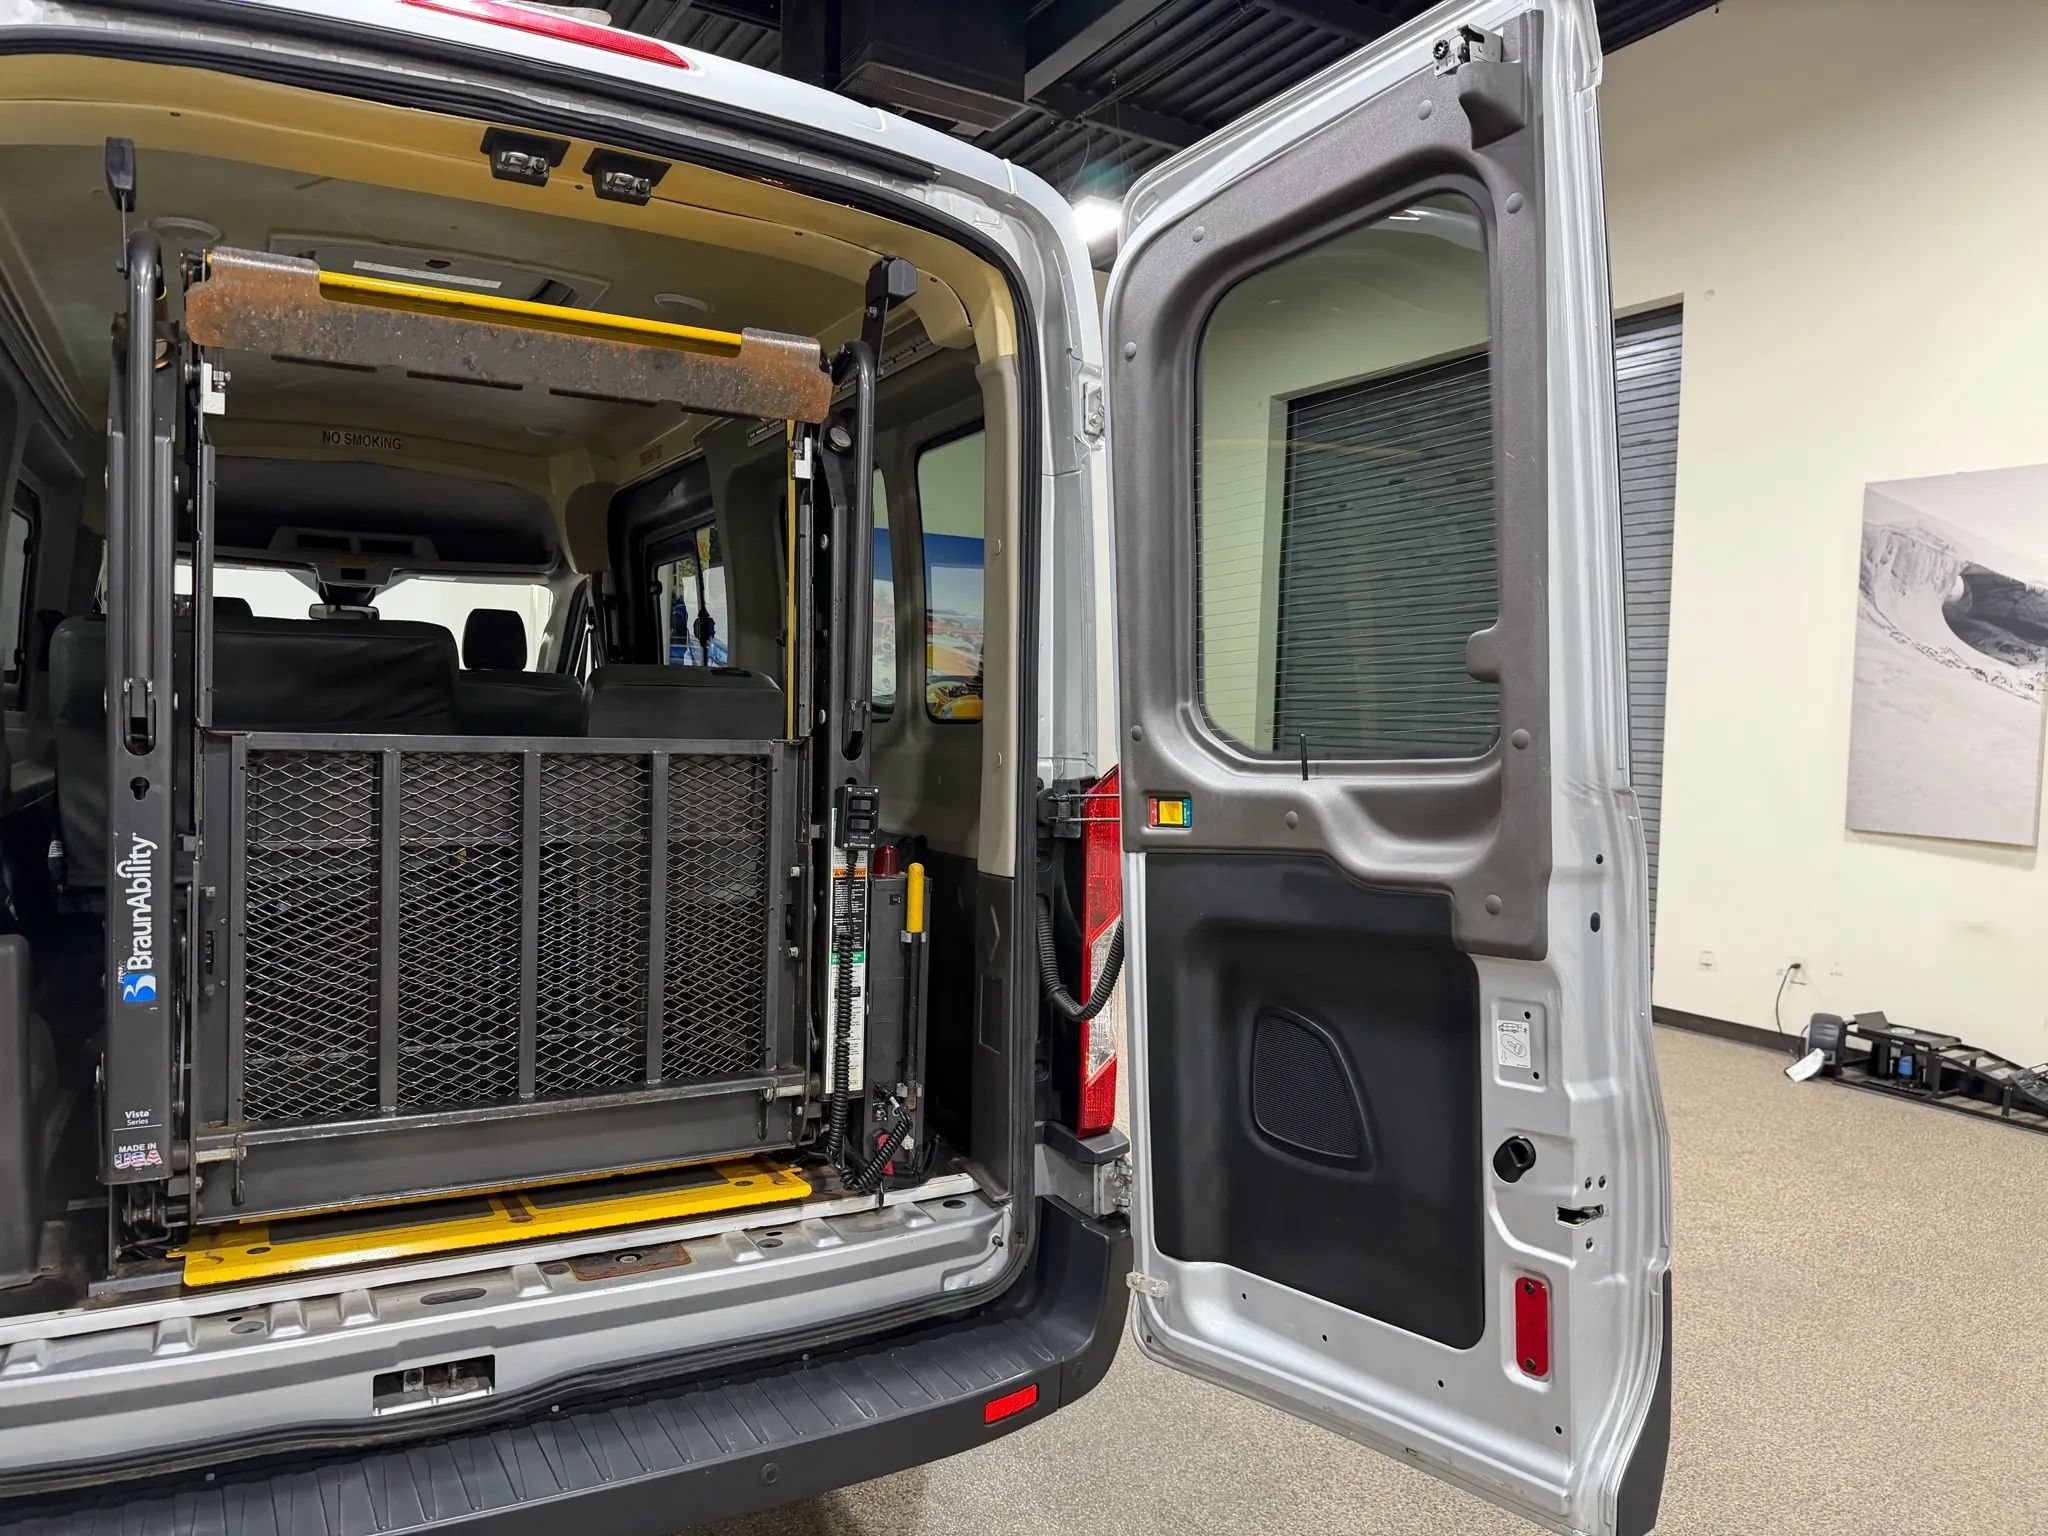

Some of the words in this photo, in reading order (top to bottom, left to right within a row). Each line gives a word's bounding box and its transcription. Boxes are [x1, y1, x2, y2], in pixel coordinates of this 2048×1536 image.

[322, 430, 341, 444] NO
[343, 432, 402, 450] SMOKING
[117, 833, 158, 971] BraunAbility
[125, 1110, 150, 1119] Vista
[127, 1118, 149, 1126] Series
[118, 1143, 146, 1153] MADE
[147, 1142, 157, 1150] IN
[114, 1149, 163, 1170] USA
